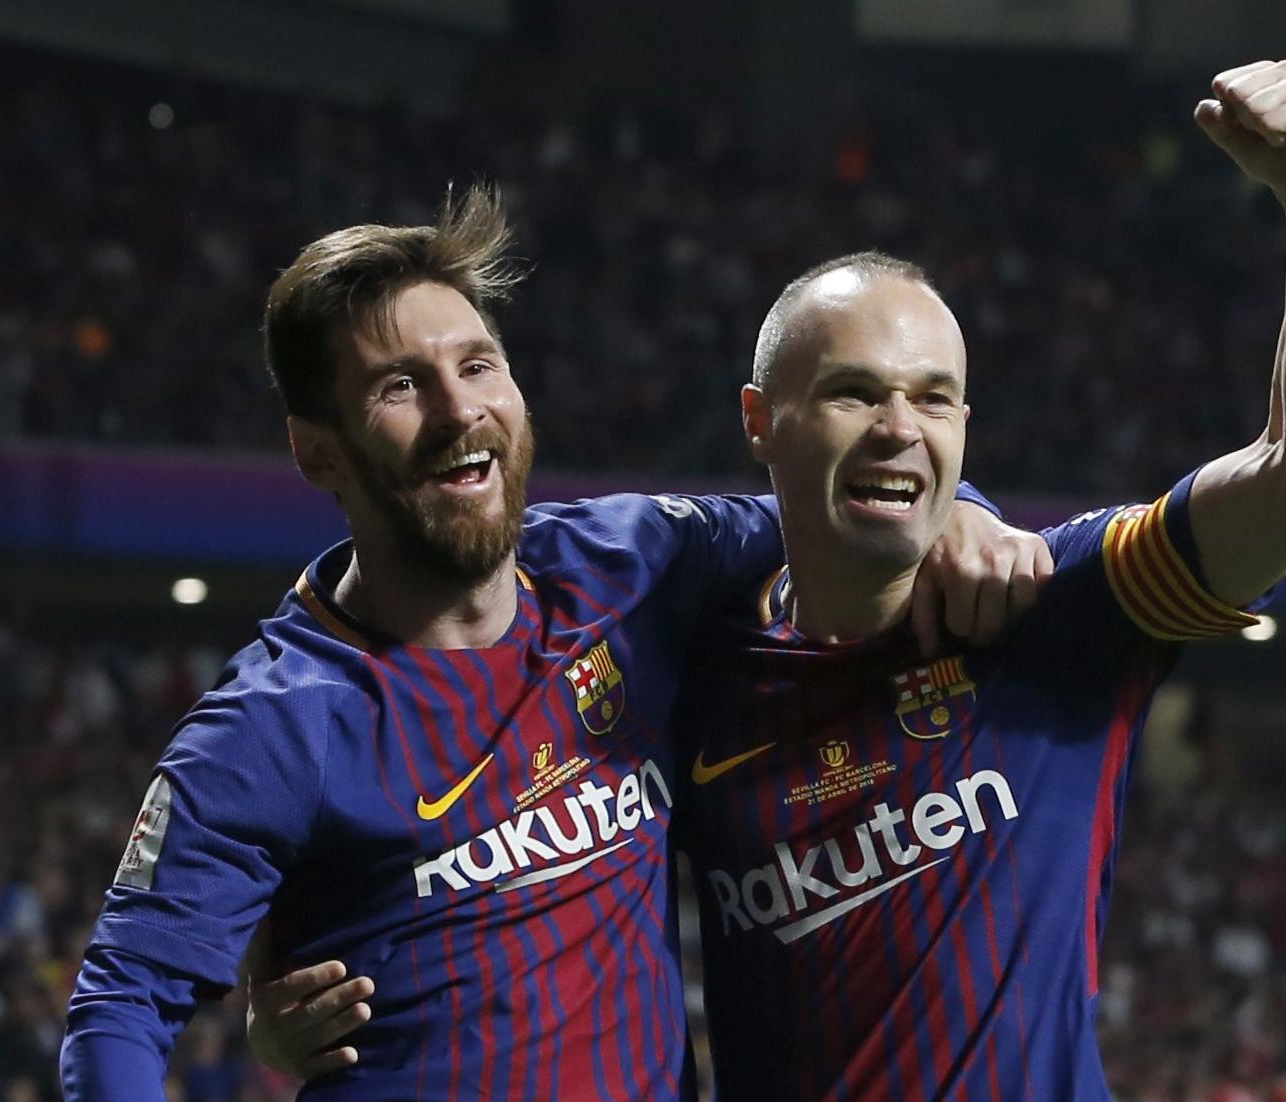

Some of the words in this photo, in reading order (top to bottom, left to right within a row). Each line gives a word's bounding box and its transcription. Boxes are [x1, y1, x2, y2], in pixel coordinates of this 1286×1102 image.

[784, 791, 813, 805] ESTADIO
[814, 783, 839, 796] WANDA
[840, 764, 897, 787] METROPOLITANO
[792, 781, 819, 795] SEVILLA
[820, 778, 830, 786] FC
[835, 774, 844, 782] FC
[846, 760, 887, 777] BARCELONA
[817, 795, 826, 803] DE
[827, 788, 847, 799] ABRIL
[848, 784, 858, 792] DE
[414, 759, 673, 898] Rakuten
[707, 769, 1019, 937] Rakuten
